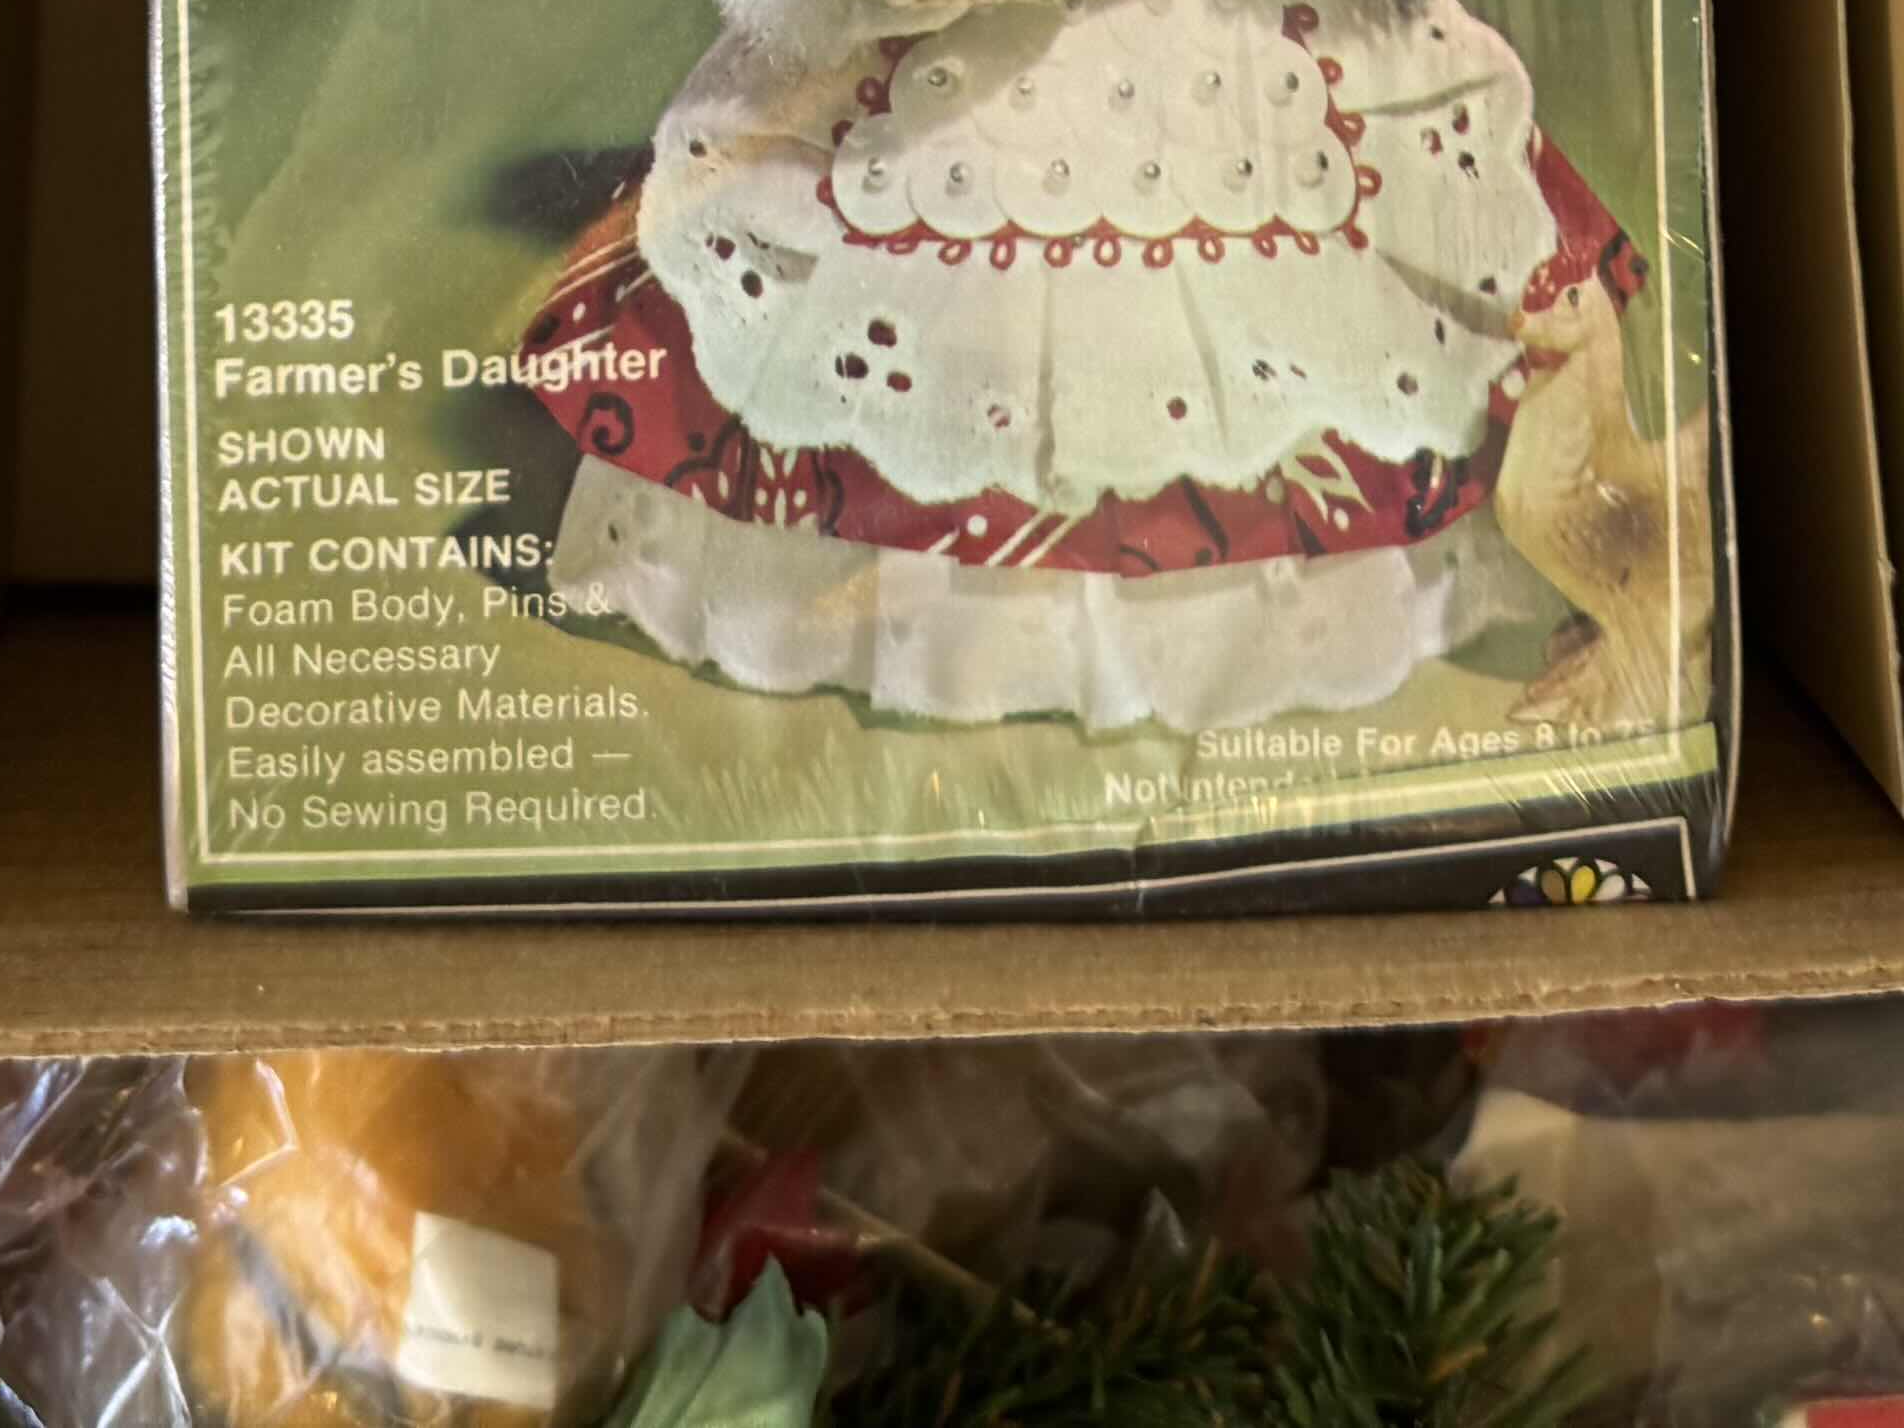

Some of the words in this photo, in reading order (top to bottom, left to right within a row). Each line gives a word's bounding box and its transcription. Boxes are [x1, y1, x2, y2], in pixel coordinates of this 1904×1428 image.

[215, 299, 355, 343] 13335
[215, 351, 424, 399] Farmer's
[442, 345, 668, 396] Daughter
[218, 427, 385, 467] SHOWN
[218, 475, 400, 512] ACTUAL
[414, 469, 511, 505] SIZE
[221, 540, 293, 577] KIT
[308, 532, 555, 574] CONTAINS:
[223, 591, 333, 628] Foam
[351, 587, 466, 633] Body,
[482, 586, 567, 619] Pins
[586, 581, 613, 617] &
[224, 644, 274, 679] All
[293, 641, 502, 680] Necessary
[226, 692, 442, 730] Decorative
[457, 685, 651, 723] Materials.
[228, 745, 345, 787] Easily
[361, 737, 575, 776] assembled
[1196, 726, 1343, 760] Suitable
[1355, 724, 1417, 759] For
[1429, 723, 1521, 760] Ages
[1535, 721, 1556, 750] 8
[1568, 720, 1603, 750] to
[228, 795, 287, 831] No
[302, 790, 448, 833] Sewing
[465, 785, 658, 828] Required.
[1104, 771, 1170, 806] Not
